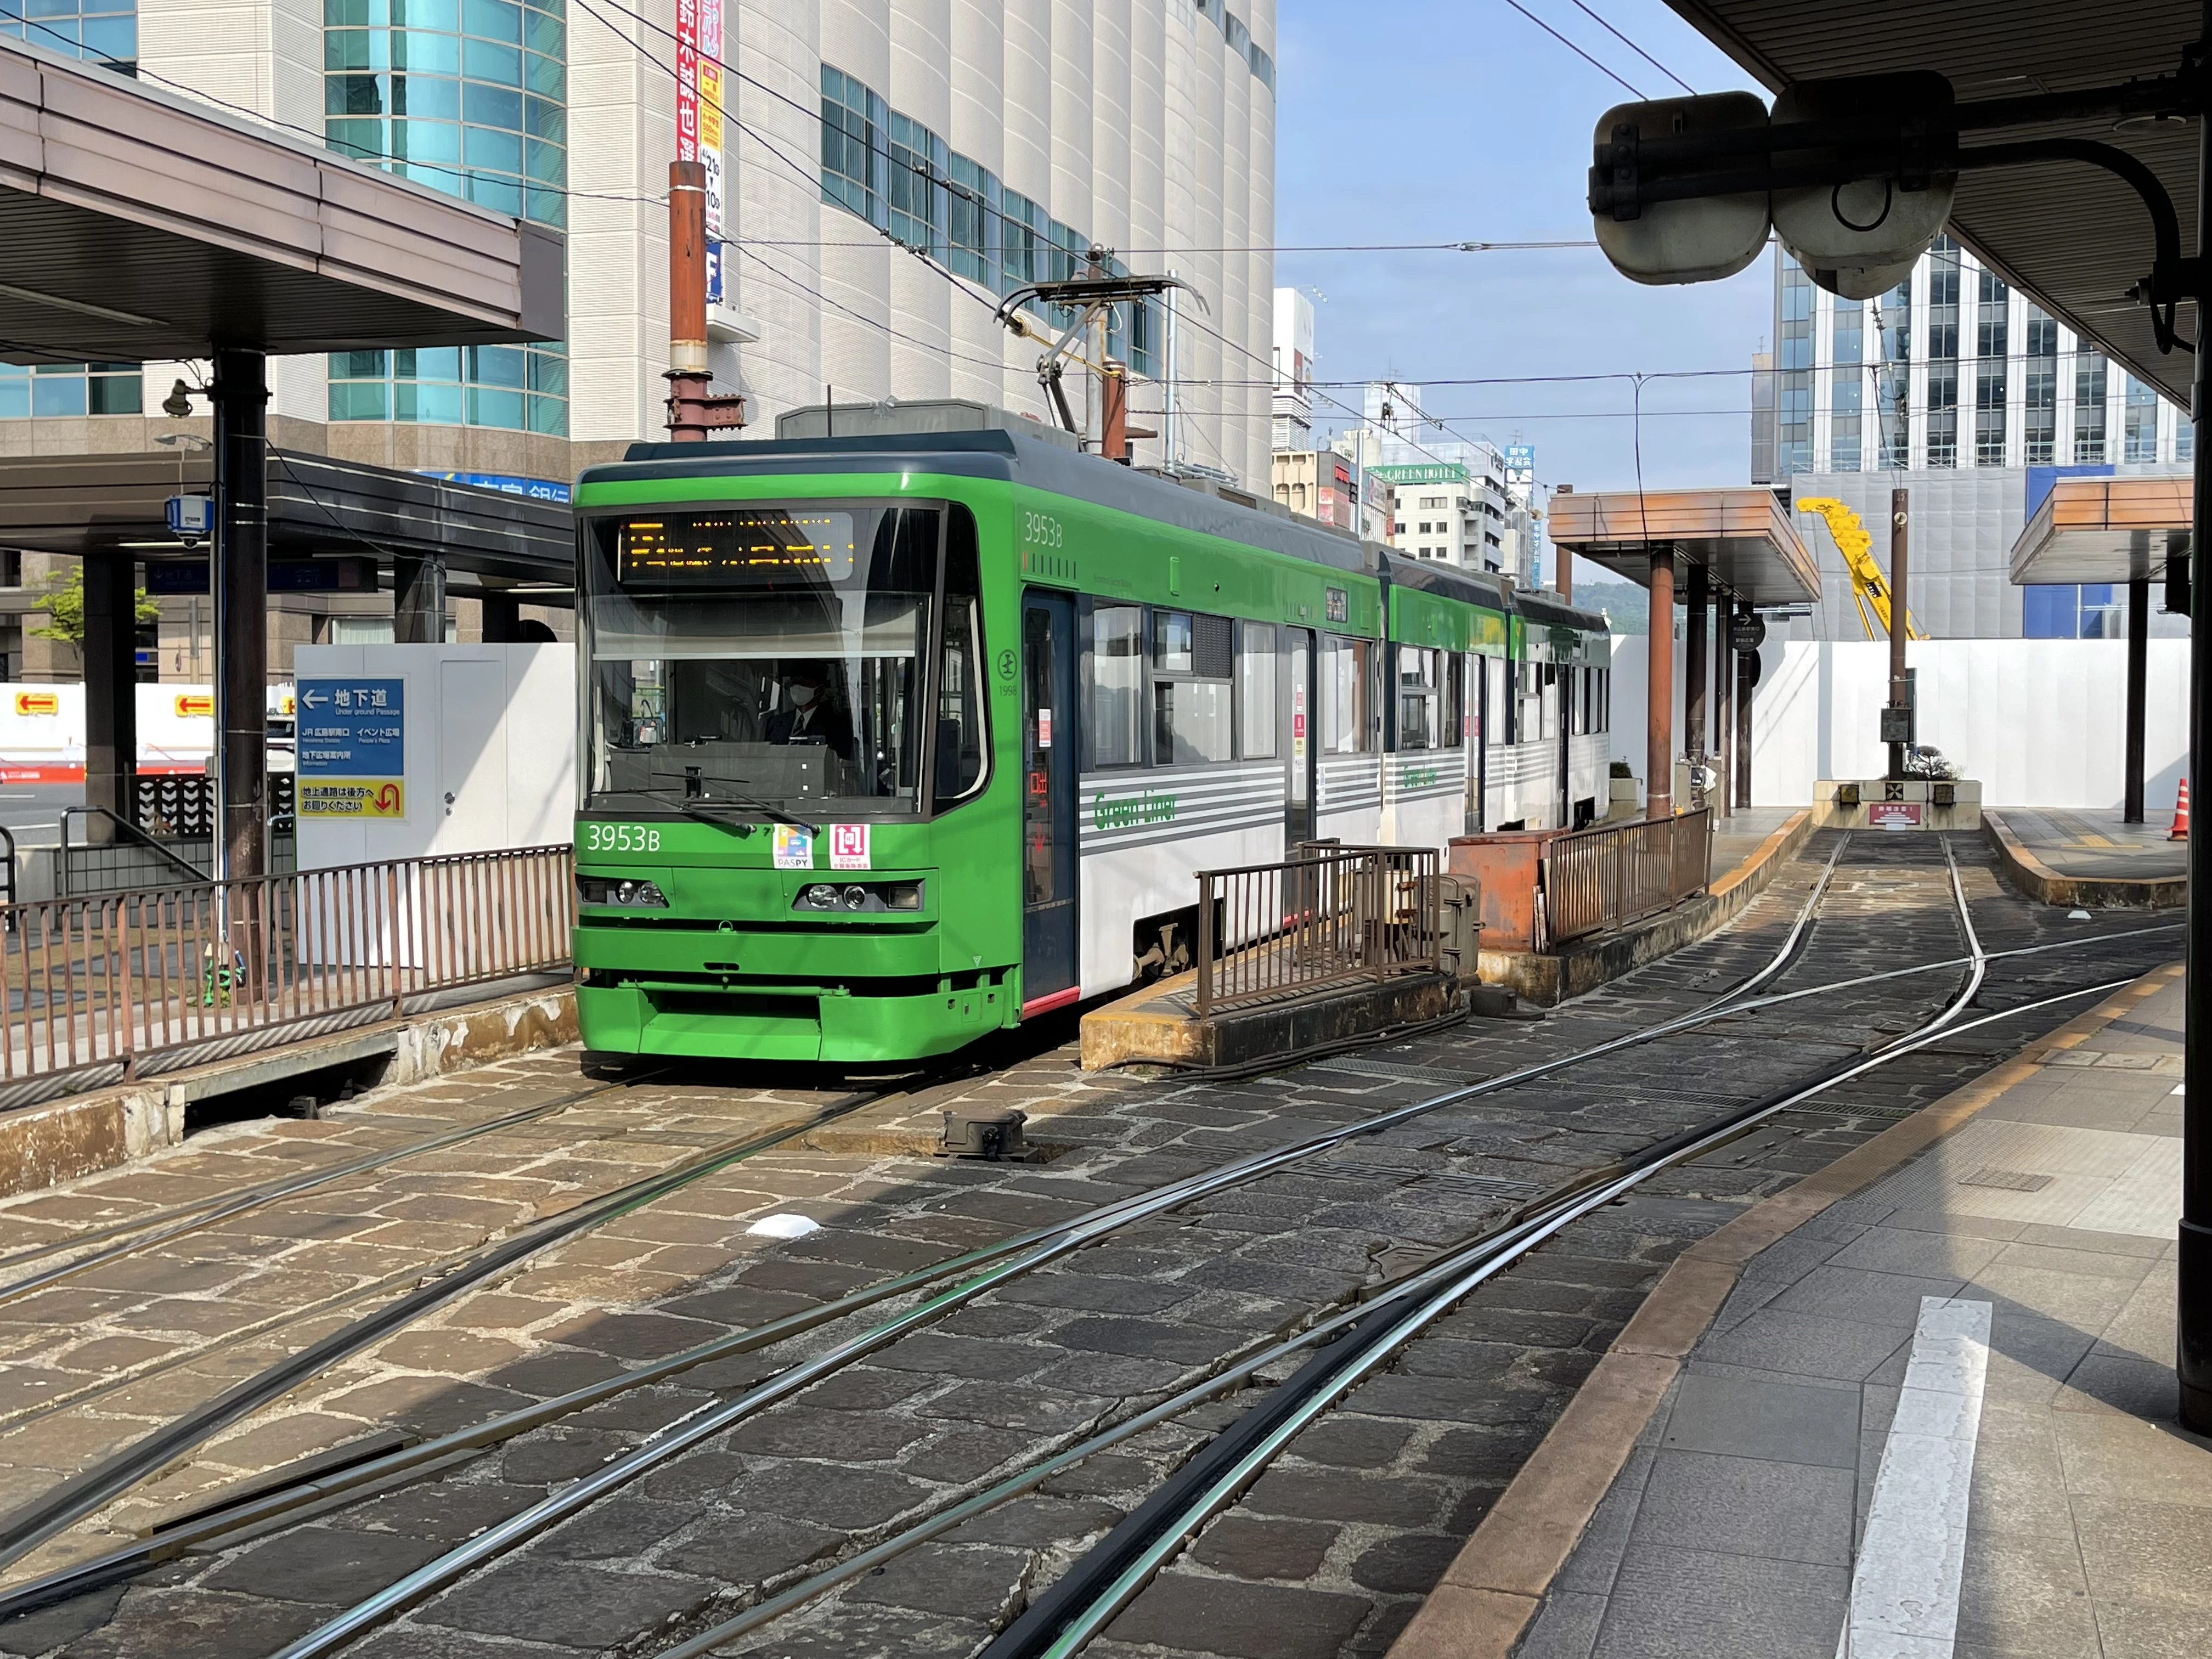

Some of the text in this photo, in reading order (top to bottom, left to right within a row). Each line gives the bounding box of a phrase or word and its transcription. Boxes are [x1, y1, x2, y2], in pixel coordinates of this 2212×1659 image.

[1509, 447, 1528, 456] 田中
[1387, 468, 1455, 480] GREEN HOTEL
[1025, 511, 1063, 548] 3953B
[998, 685, 1017, 696] 1998
[335, 689, 387, 707] 地下道
[303, 787, 374, 797] 地上通路は後方へ
[303, 800, 363, 811] お回りください
[1093, 786, 1177, 830] Green Liner
[588, 824, 661, 852] 3953B
[778, 859, 808, 867] PASPY
